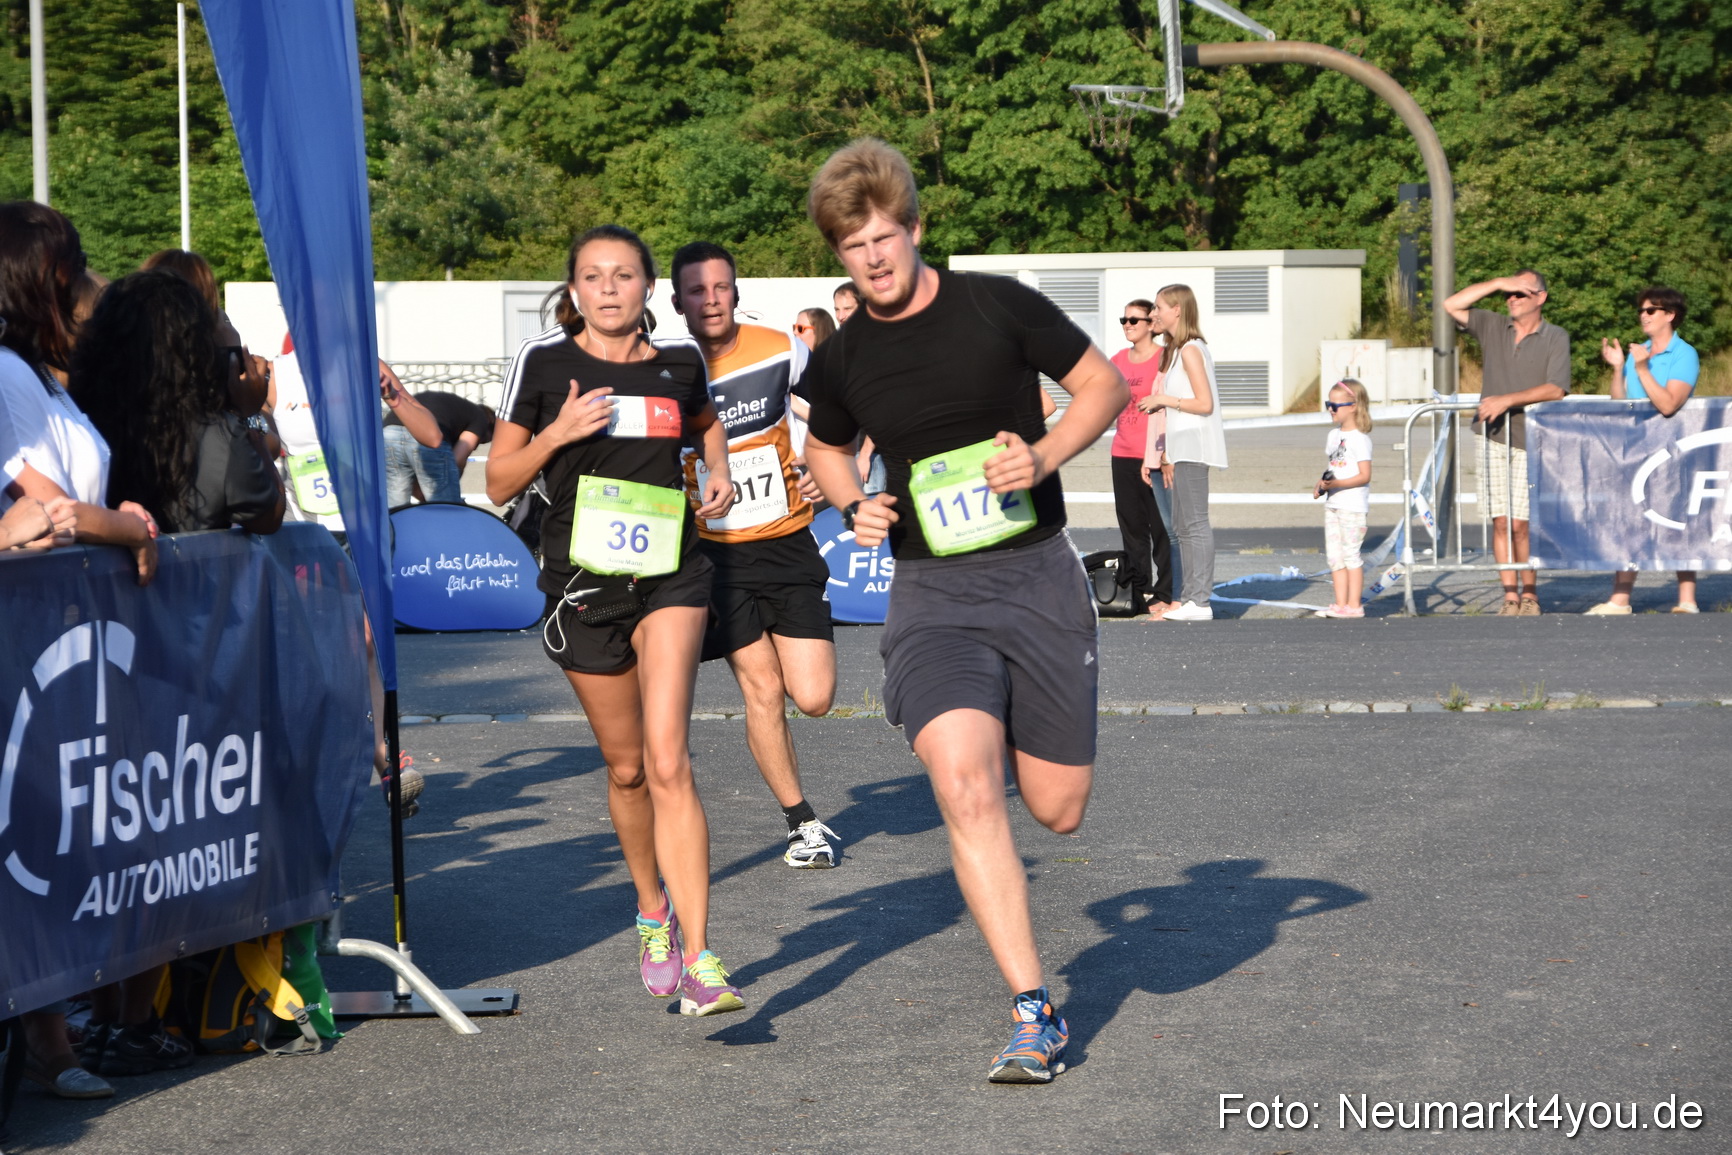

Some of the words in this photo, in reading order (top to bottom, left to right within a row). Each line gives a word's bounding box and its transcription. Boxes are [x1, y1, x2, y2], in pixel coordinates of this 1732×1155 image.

[607, 520, 650, 553] 36
[400, 557, 431, 577] und
[435, 553, 462, 570] das
[446, 574, 485, 598] fährt
[488, 573, 519, 589] mit!
[72, 832, 259, 921] AUTOMOBILE
